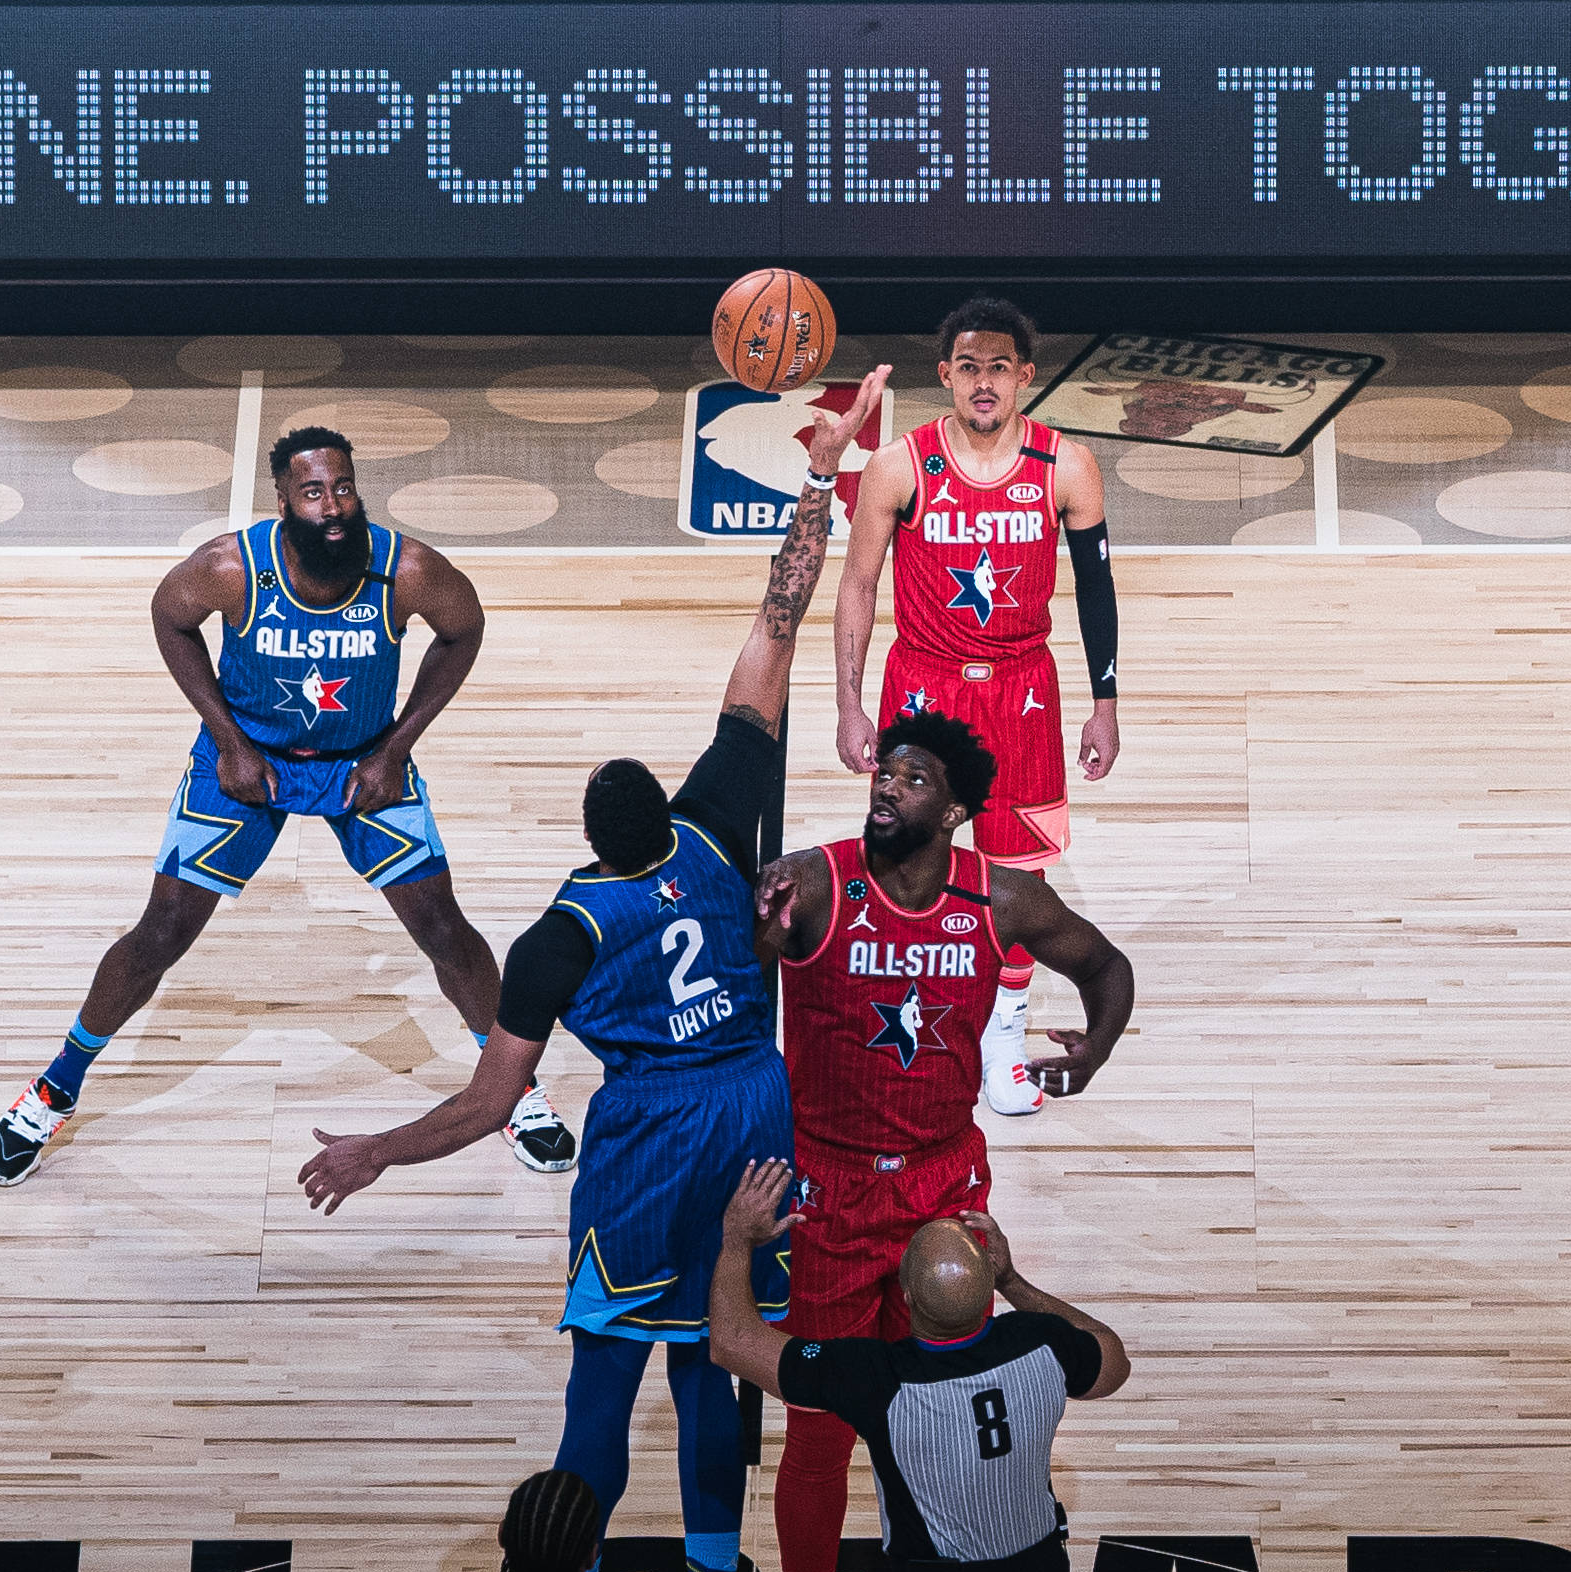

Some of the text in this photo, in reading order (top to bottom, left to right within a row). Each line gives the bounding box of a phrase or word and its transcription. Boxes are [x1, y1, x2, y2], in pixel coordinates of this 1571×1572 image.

[305, 67, 1162, 204] POSSIBLE
[1105, 335, 1363, 376] CHICAGO
[1118, 354, 1305, 389] BULLS
[1010, 486, 1040, 500] KIA
[923, 511, 1044, 544] ALL-STAR
[346, 606, 374, 620] KIA
[256, 626, 377, 659] ALL-STAR
[946, 915, 975, 931] KIA
[661, 918, 719, 1007] 2
[848, 940, 976, 978] ALL-STAR
[668, 989, 734, 1044] DAVIS
[970, 1387, 1012, 1461] 8
